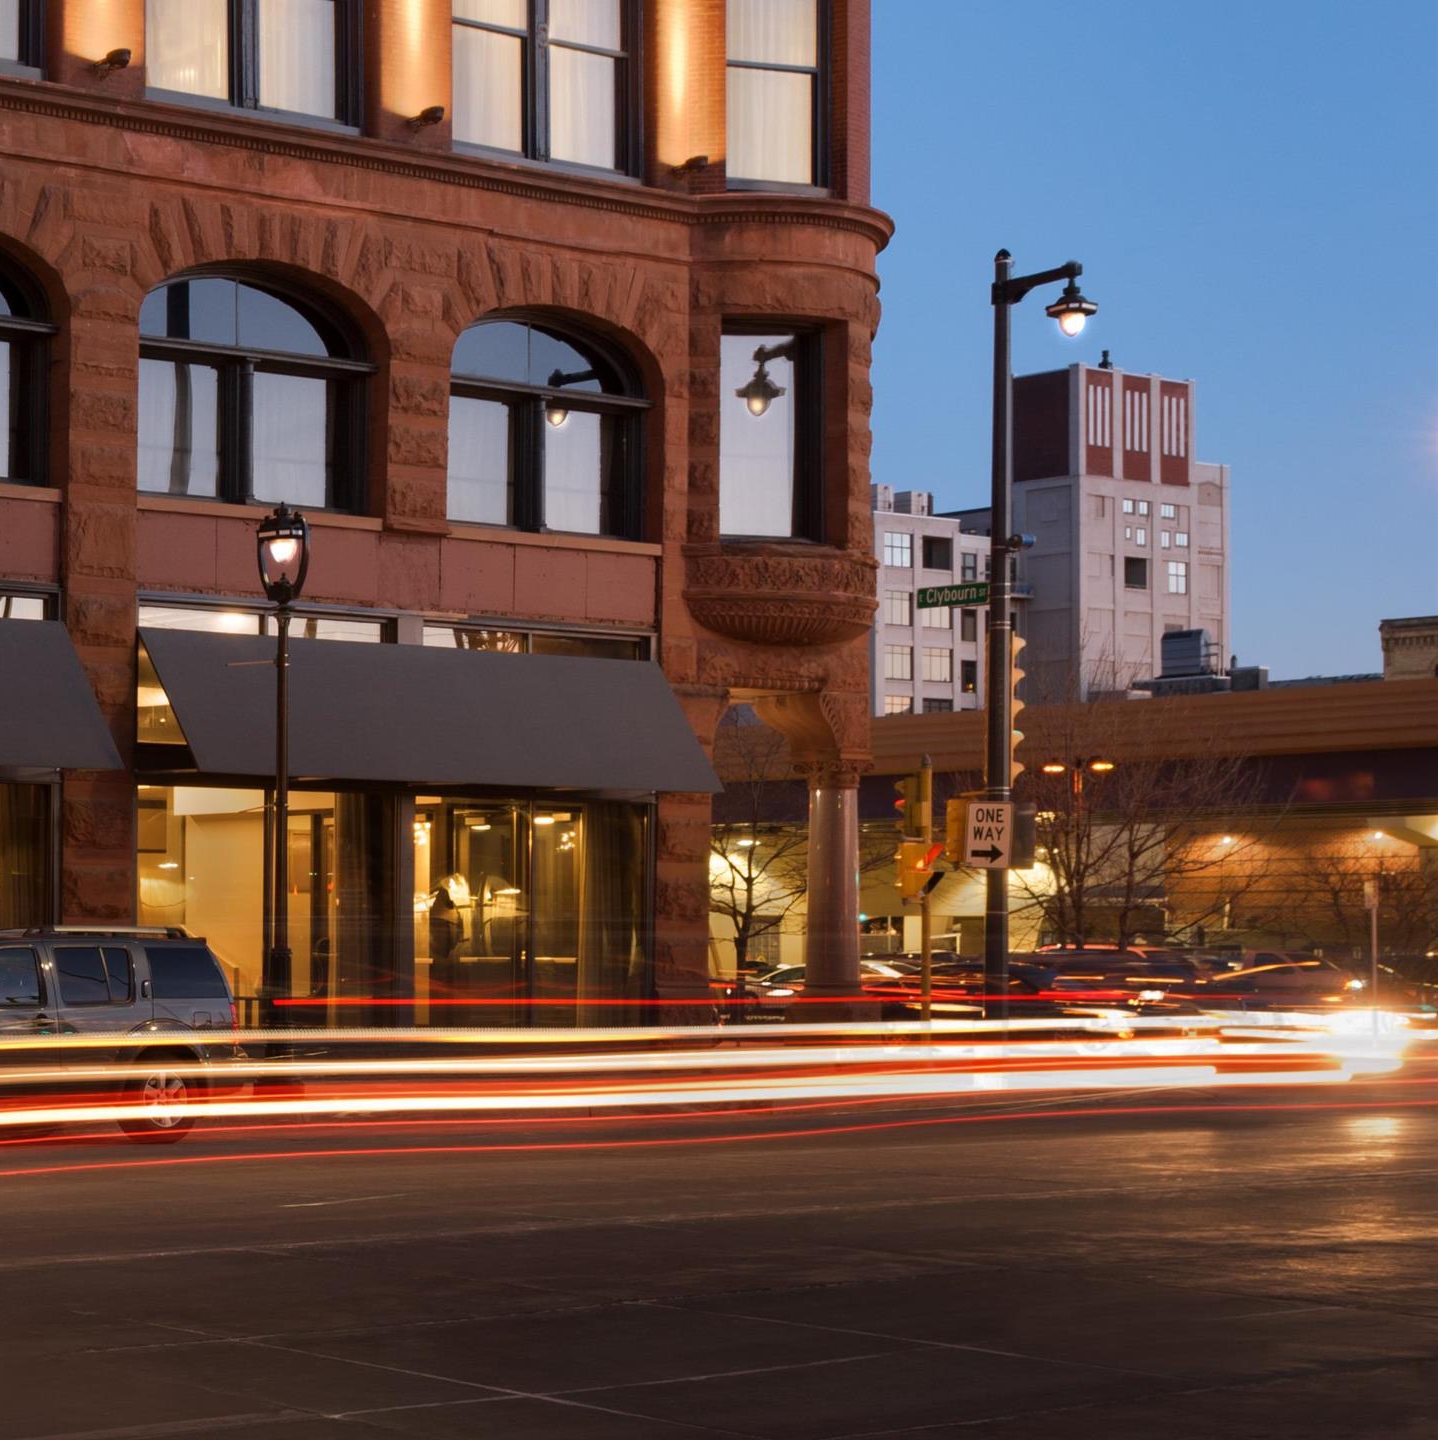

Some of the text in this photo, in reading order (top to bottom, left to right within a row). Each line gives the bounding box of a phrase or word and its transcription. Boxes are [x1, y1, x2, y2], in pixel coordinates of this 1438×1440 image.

[926, 587, 977, 605] Clybourn
[975, 808, 1004, 823] ONE
[973, 826, 1004, 841] WAY
